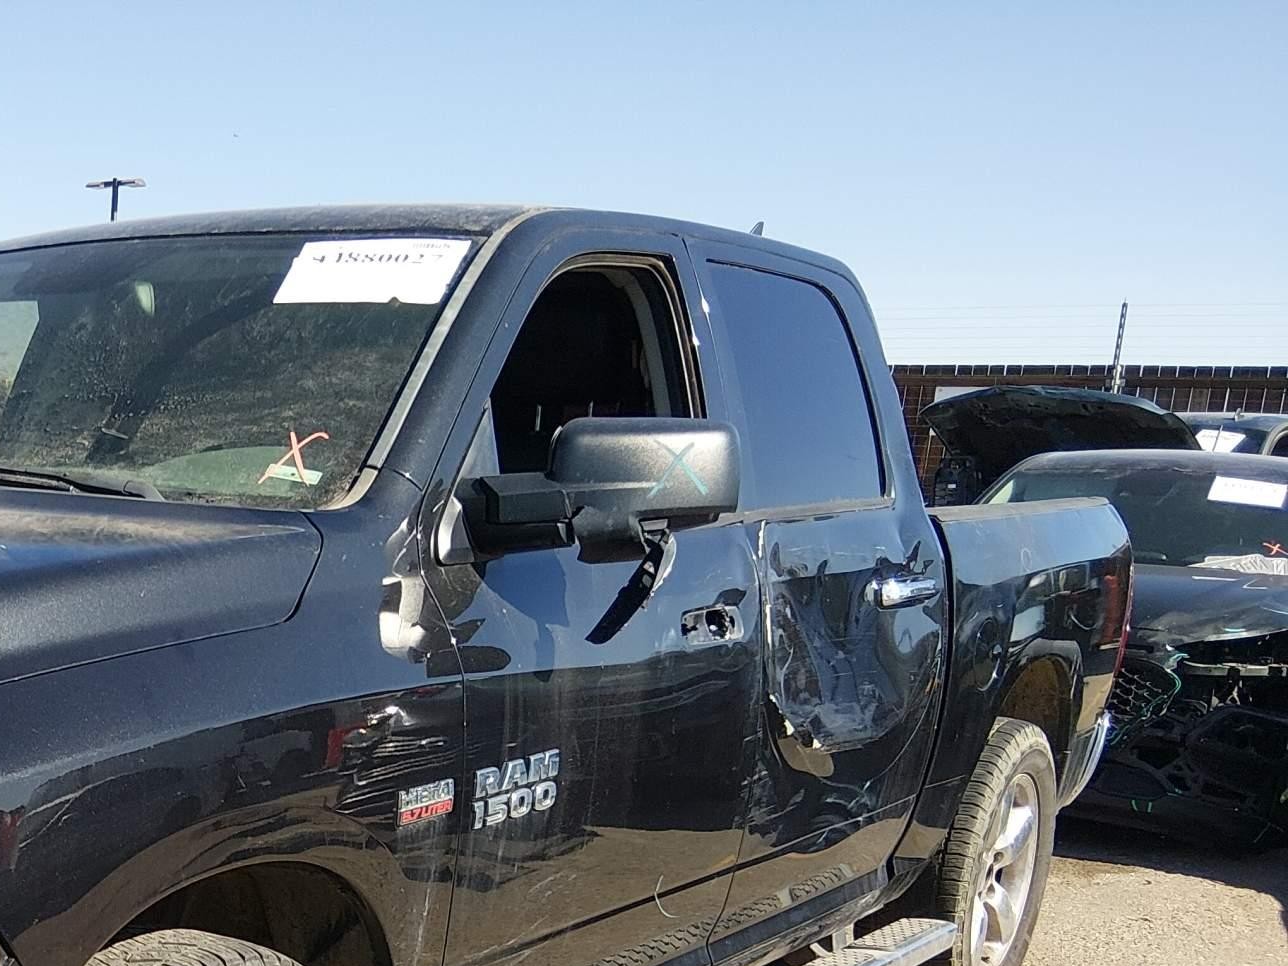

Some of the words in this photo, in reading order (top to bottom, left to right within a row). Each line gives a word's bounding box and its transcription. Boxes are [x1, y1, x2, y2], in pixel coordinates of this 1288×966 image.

[474, 748, 560, 799] RAM
[421, 800, 452, 818] LITER
[471, 780, 557, 830] 1500
